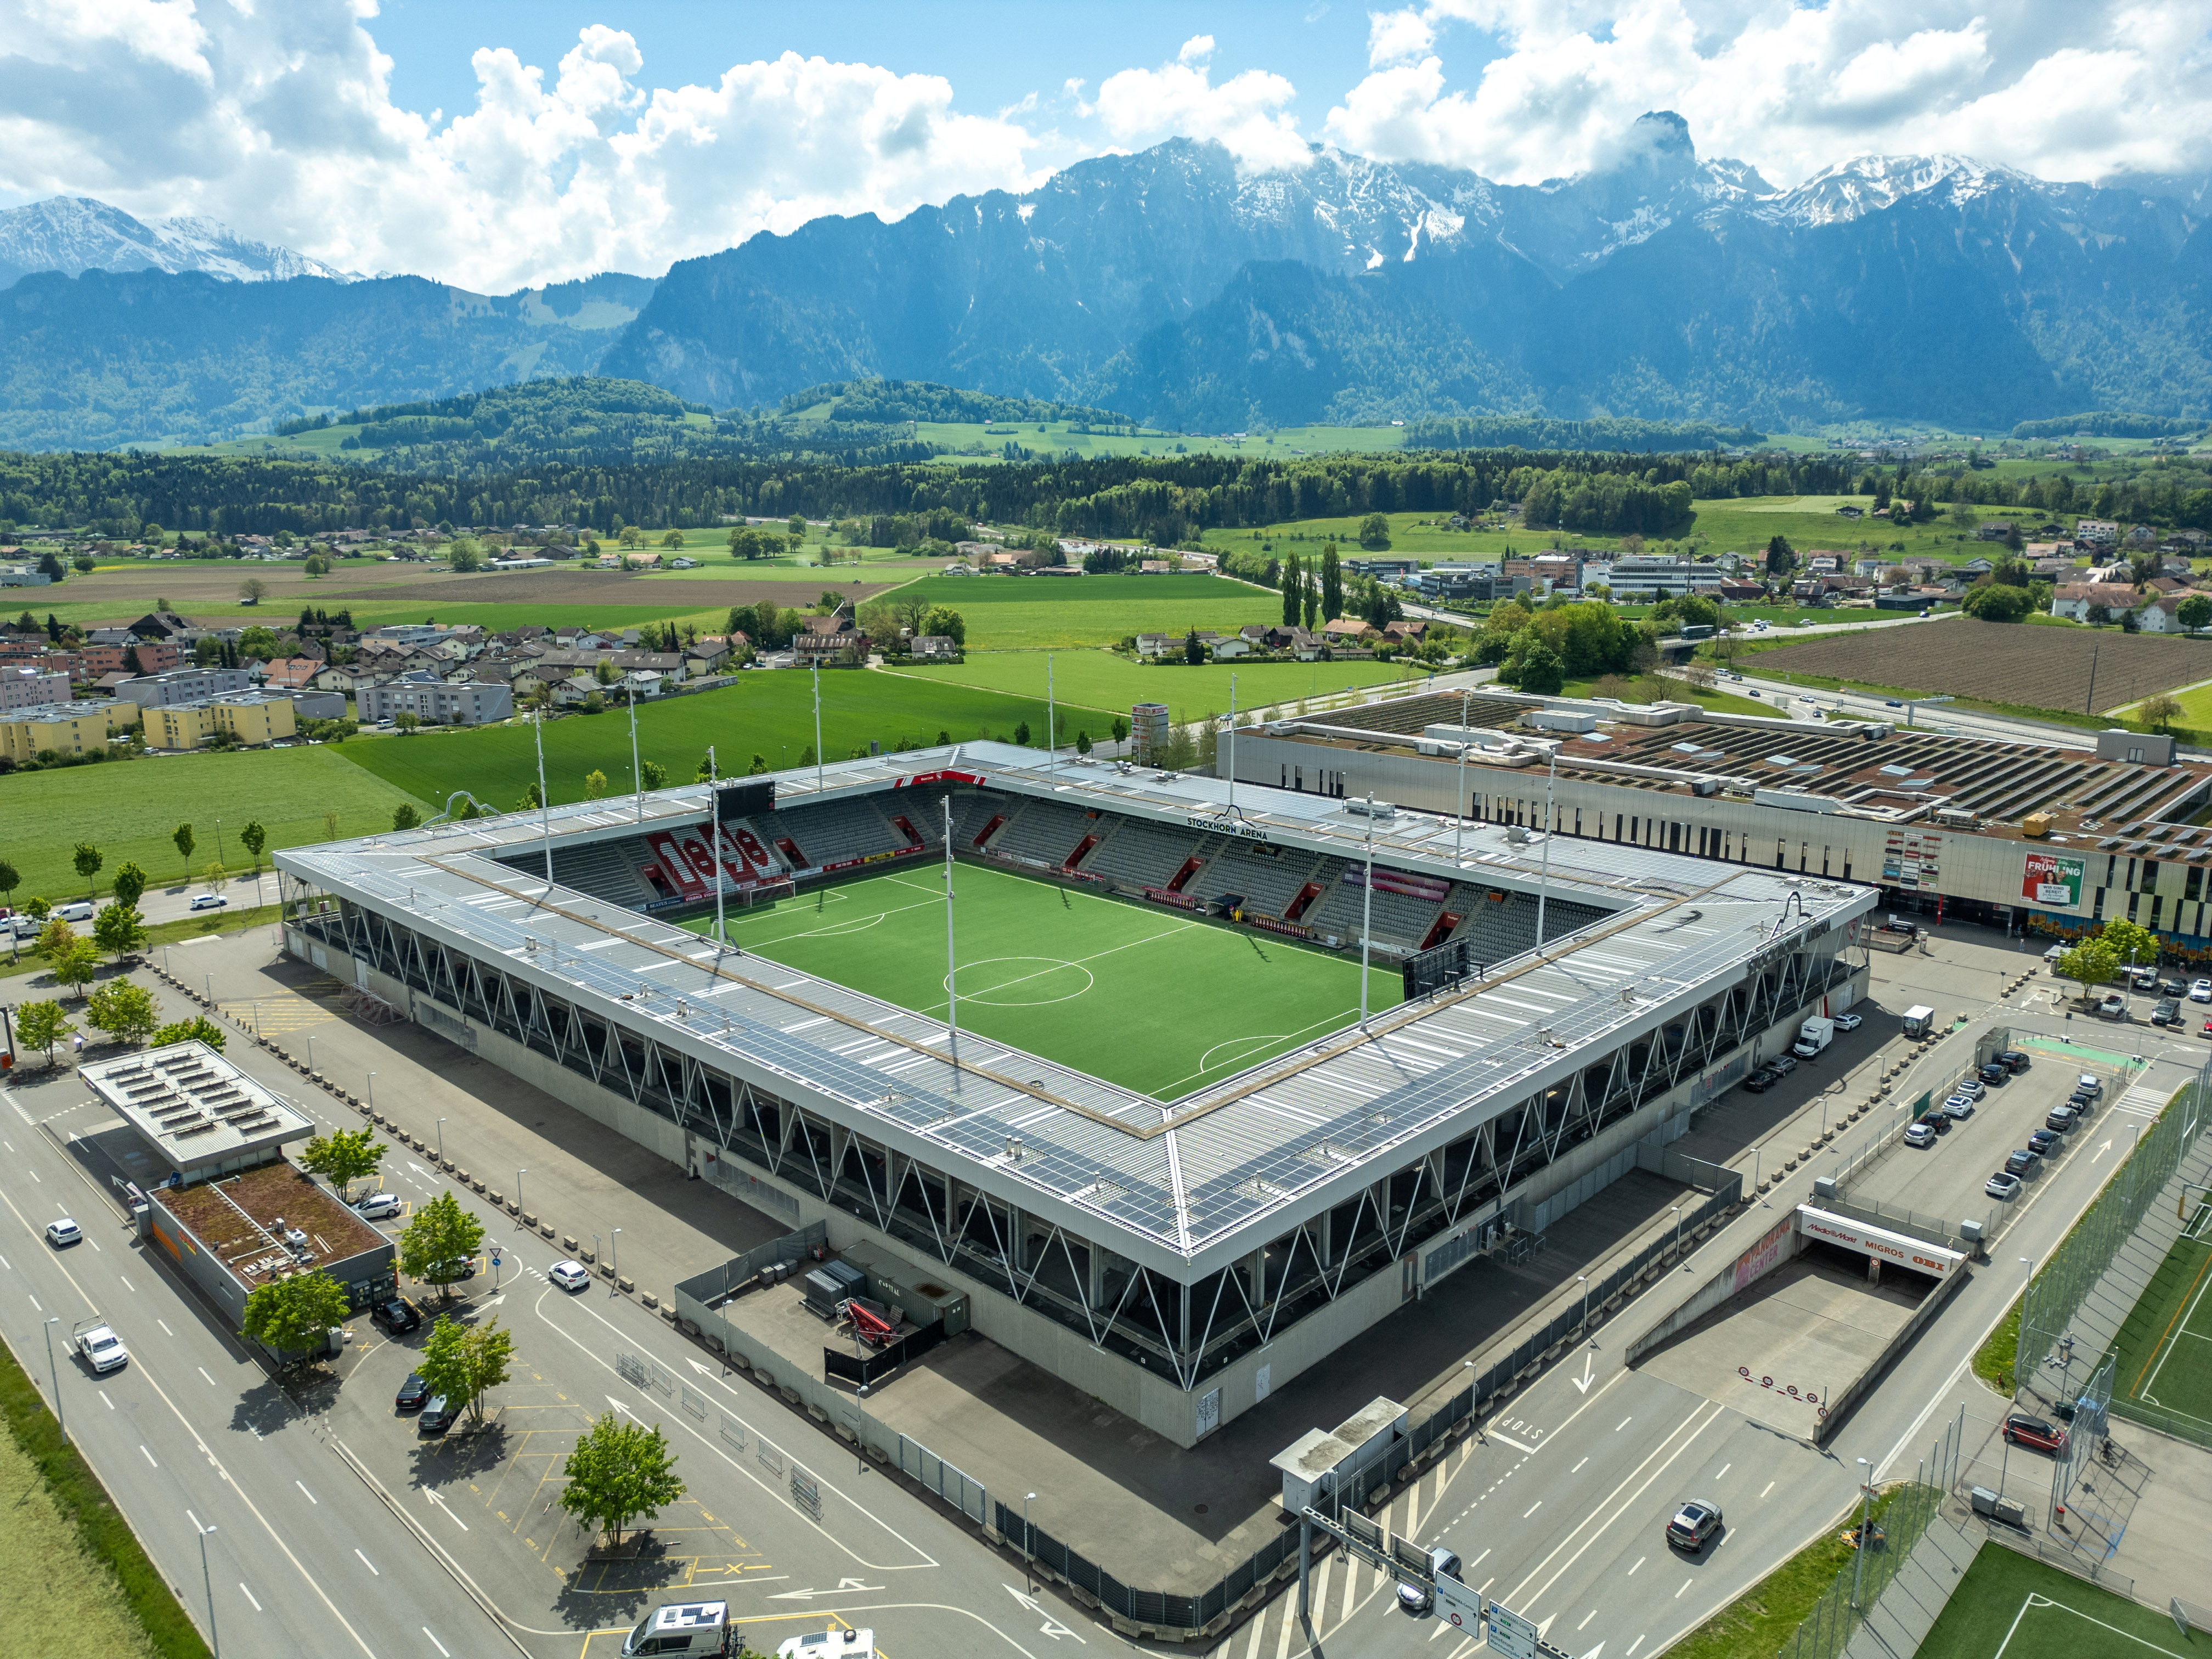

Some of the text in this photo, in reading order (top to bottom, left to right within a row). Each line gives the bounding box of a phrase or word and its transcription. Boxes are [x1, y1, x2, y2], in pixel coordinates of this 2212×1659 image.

[1187, 817, 1268, 840] STOCKHORN ARENA
[1752, 1034, 1763, 1069] C
[1751, 1219, 1790, 1262] PANORAMA
[1865, 1240, 1904, 1259] MIGROS
[1750, 1244, 1778, 1278] CENTER
[1912, 1255, 1945, 1272] OBI
[878, 1279, 900, 1297] CAPITAL
[1502, 1417, 1543, 1439] STOP
